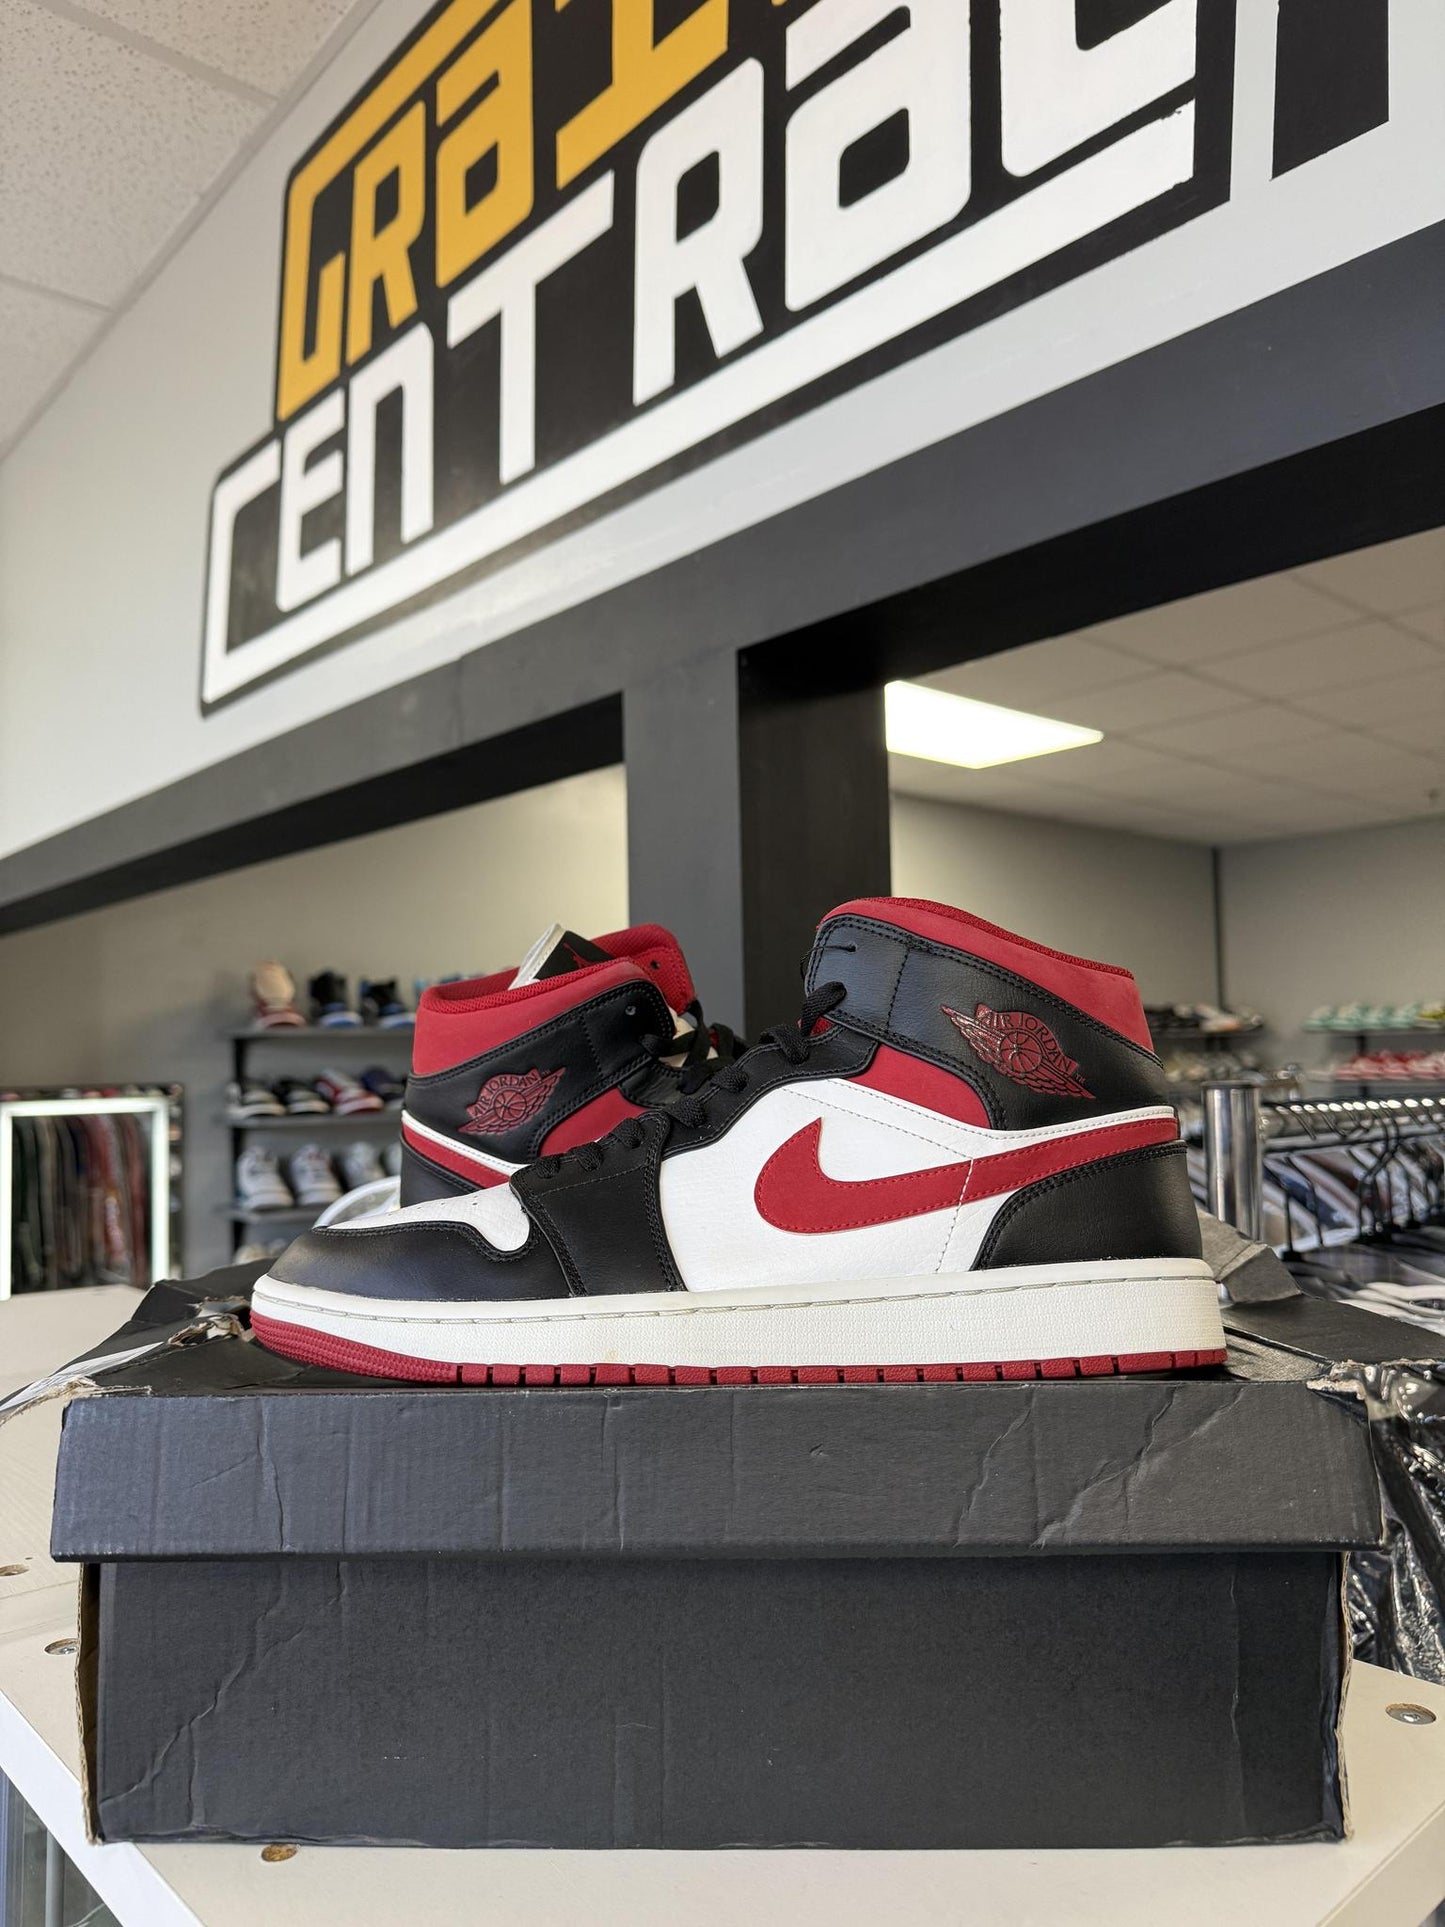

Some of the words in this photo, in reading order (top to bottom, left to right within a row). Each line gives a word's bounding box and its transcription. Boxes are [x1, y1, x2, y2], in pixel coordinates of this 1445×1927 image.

[979, 1012, 1014, 1028] AIR
[1018, 1012, 1072, 1073] JORDAN
[472, 1095, 491, 1118] AIR
[485, 1072, 539, 1096] JORDAN
